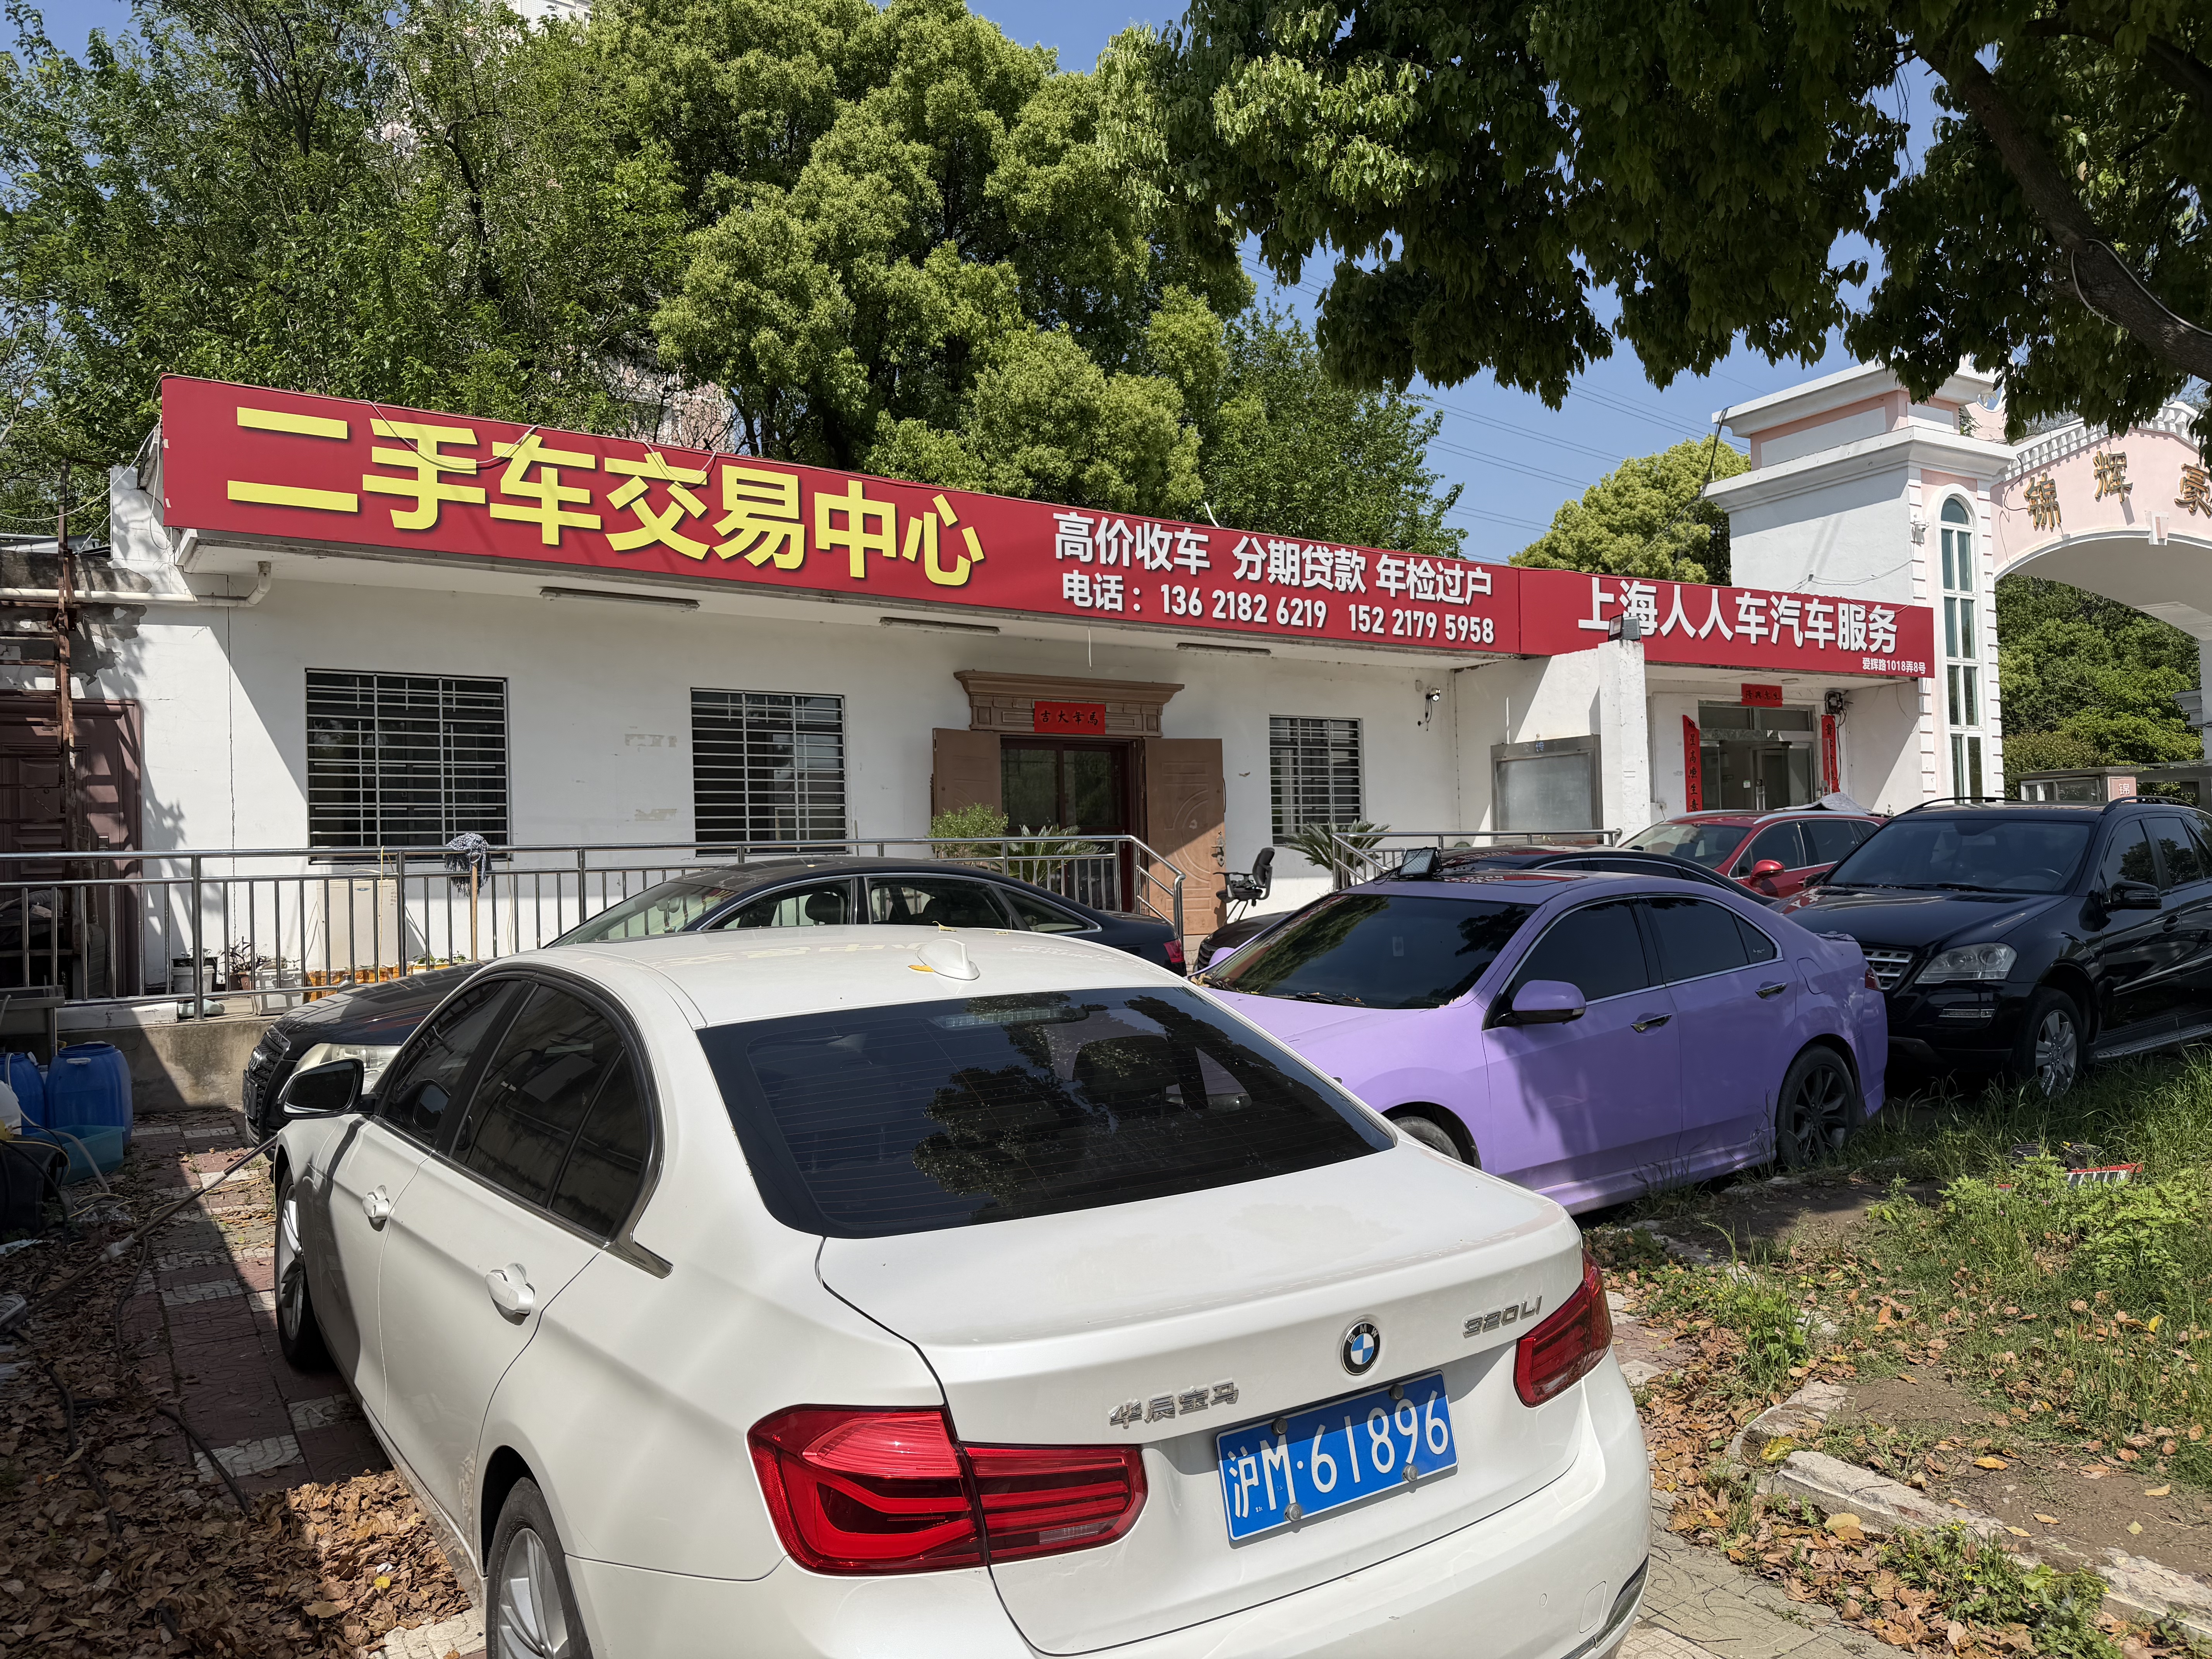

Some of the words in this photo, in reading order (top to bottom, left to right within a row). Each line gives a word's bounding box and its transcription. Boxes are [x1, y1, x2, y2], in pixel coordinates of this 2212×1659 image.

[228, 407, 984, 586] 二手车交易中心
[1053, 512, 1210, 575] 高价收车
[1232, 535, 1366, 593] 分期贷款
[1376, 554, 1492, 605] 年检过户
[1161, 584, 1202, 616] 136
[1212, 589, 1267, 623] 2182
[1276, 597, 1326, 628] 6219
[1349, 604, 1384, 634] 152
[1392, 608, 1437, 638] 2179
[1445, 614, 1494, 644] 5958
[1578, 577, 1898, 653] 上海人人车汽车服务
[1862, 657, 1926, 675] 爱辉路1018弄8号
[2119, 783, 2130, 795] 锦
[1347, 1324, 1379, 1344] BMW
[1109, 1382, 1239, 1429] 华晨宝马
